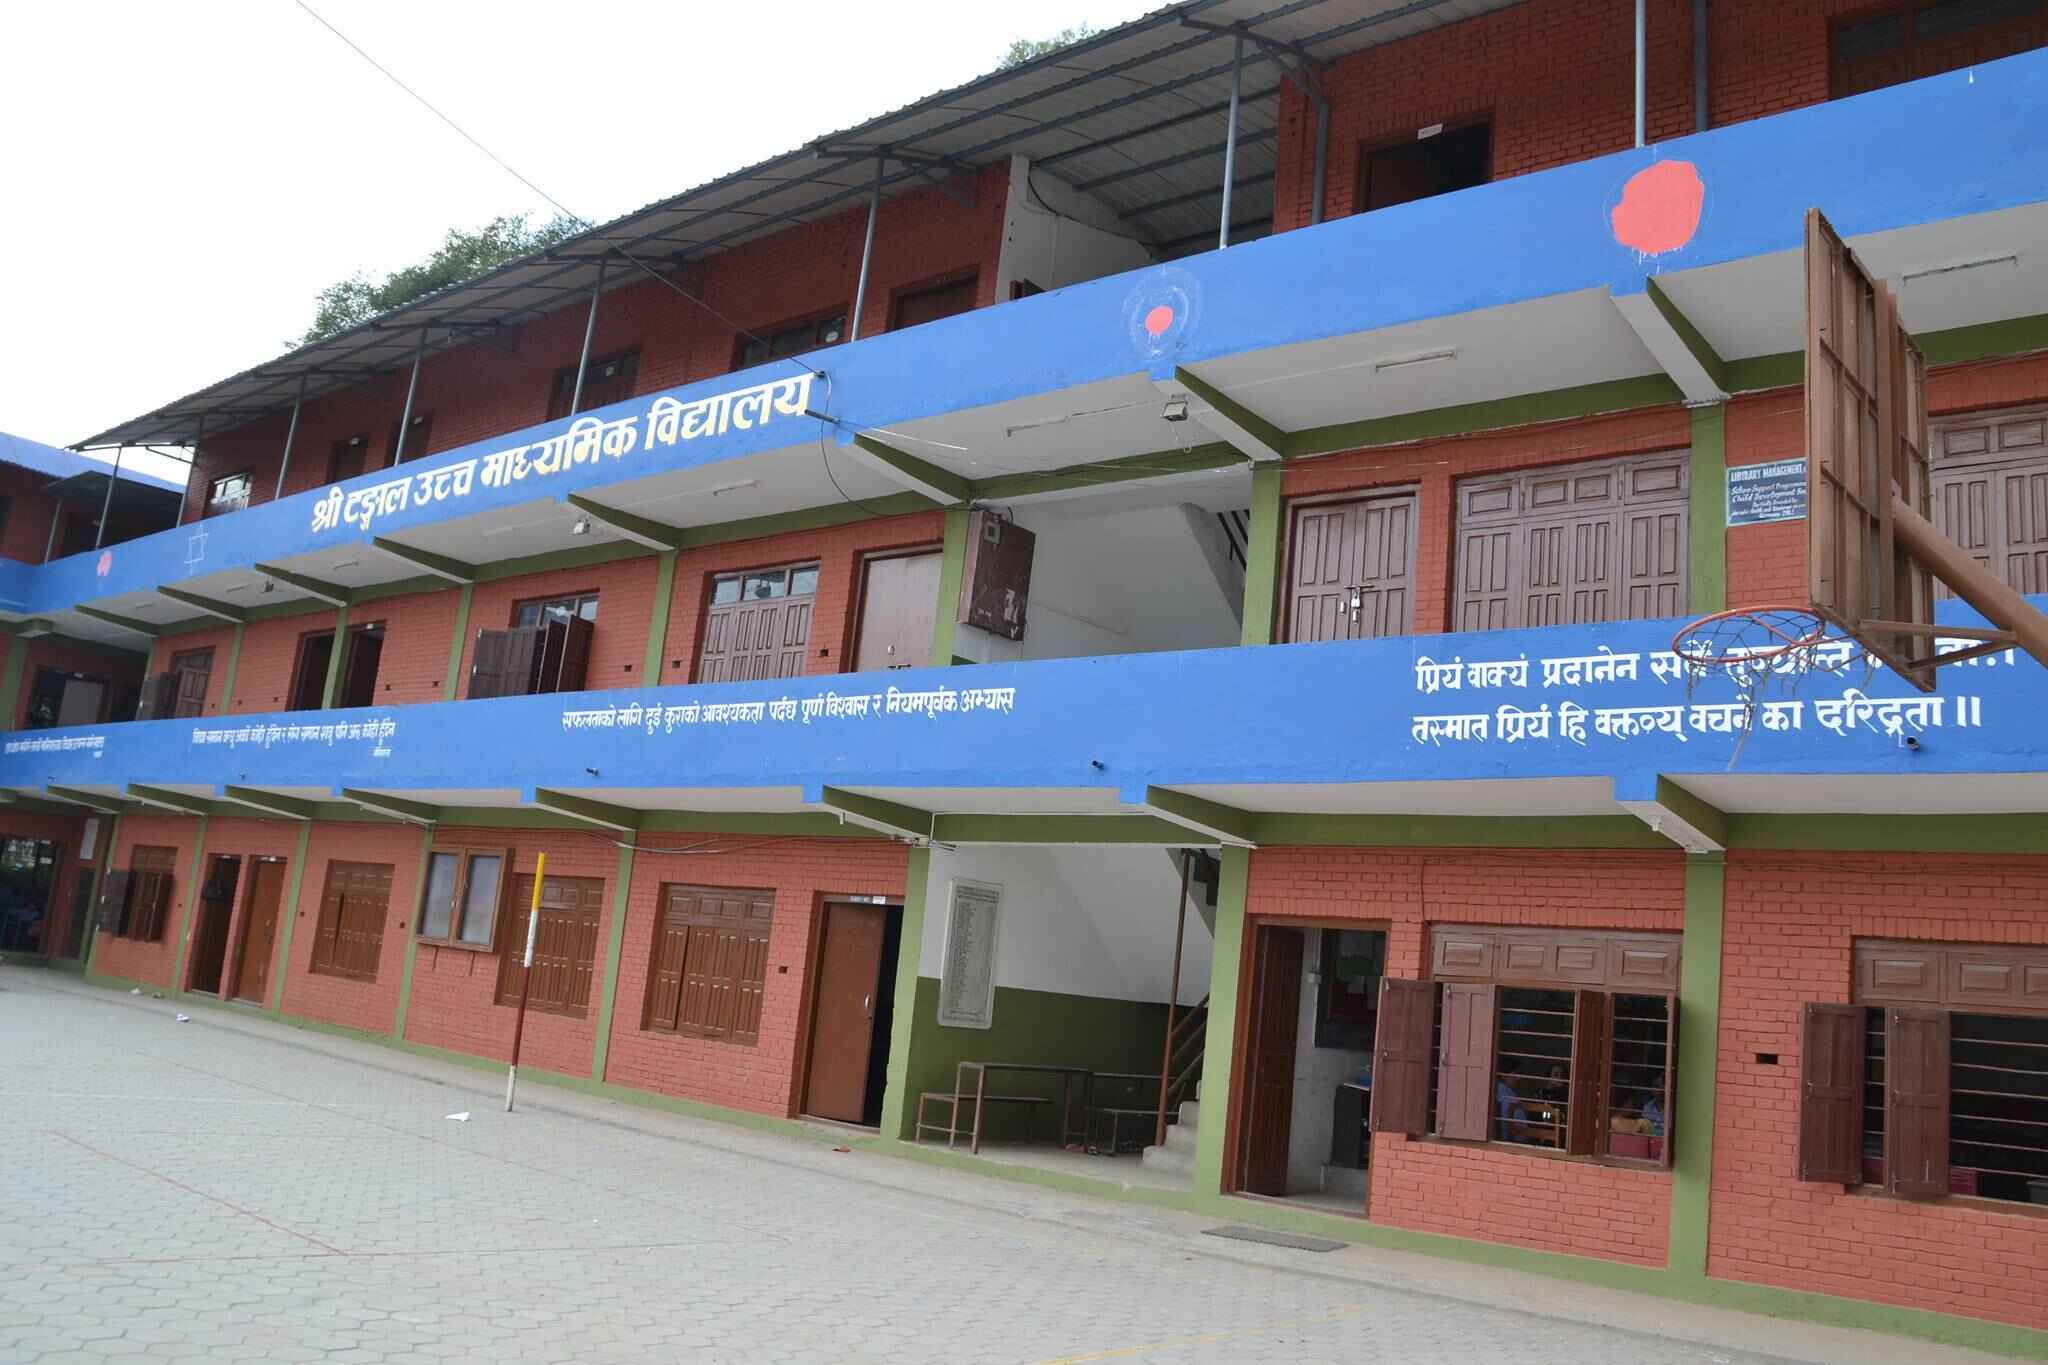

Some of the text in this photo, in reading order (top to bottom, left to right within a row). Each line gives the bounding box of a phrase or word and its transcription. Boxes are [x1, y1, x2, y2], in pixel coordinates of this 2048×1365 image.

[312, 486, 344, 532] श्री
[414, 459, 478, 505] उच्च
[481, 415, 639, 487] माध्यमिक
[644, 372, 815, 450] विद्यालय
[1415, 656, 1464, 694] प्रियं
[1467, 654, 1529, 688] वाक्यं
[1540, 645, 1640, 688] प्रदानेन
[561, 705, 615, 732] सफलताको
[617, 702, 644, 729] लागि
[664, 701, 700, 734] कुराको
[702, 702, 766, 725] आवश्यकता
[801, 693, 824, 724] पूर्ण
[826, 691, 870, 721] विश्वास
[872, 694, 883, 718] र
[886, 685, 958, 721] नियमपूर्वक
[960, 687, 1015, 714] अभ्यास
[1411, 714, 1490, 747] तस्मात
[1496, 703, 1553, 743] प्रियं
[1559, 701, 1589, 746] हि
[1762, 700, 1805, 731] का
[1814, 687, 1945, 737] दरिद्रता
